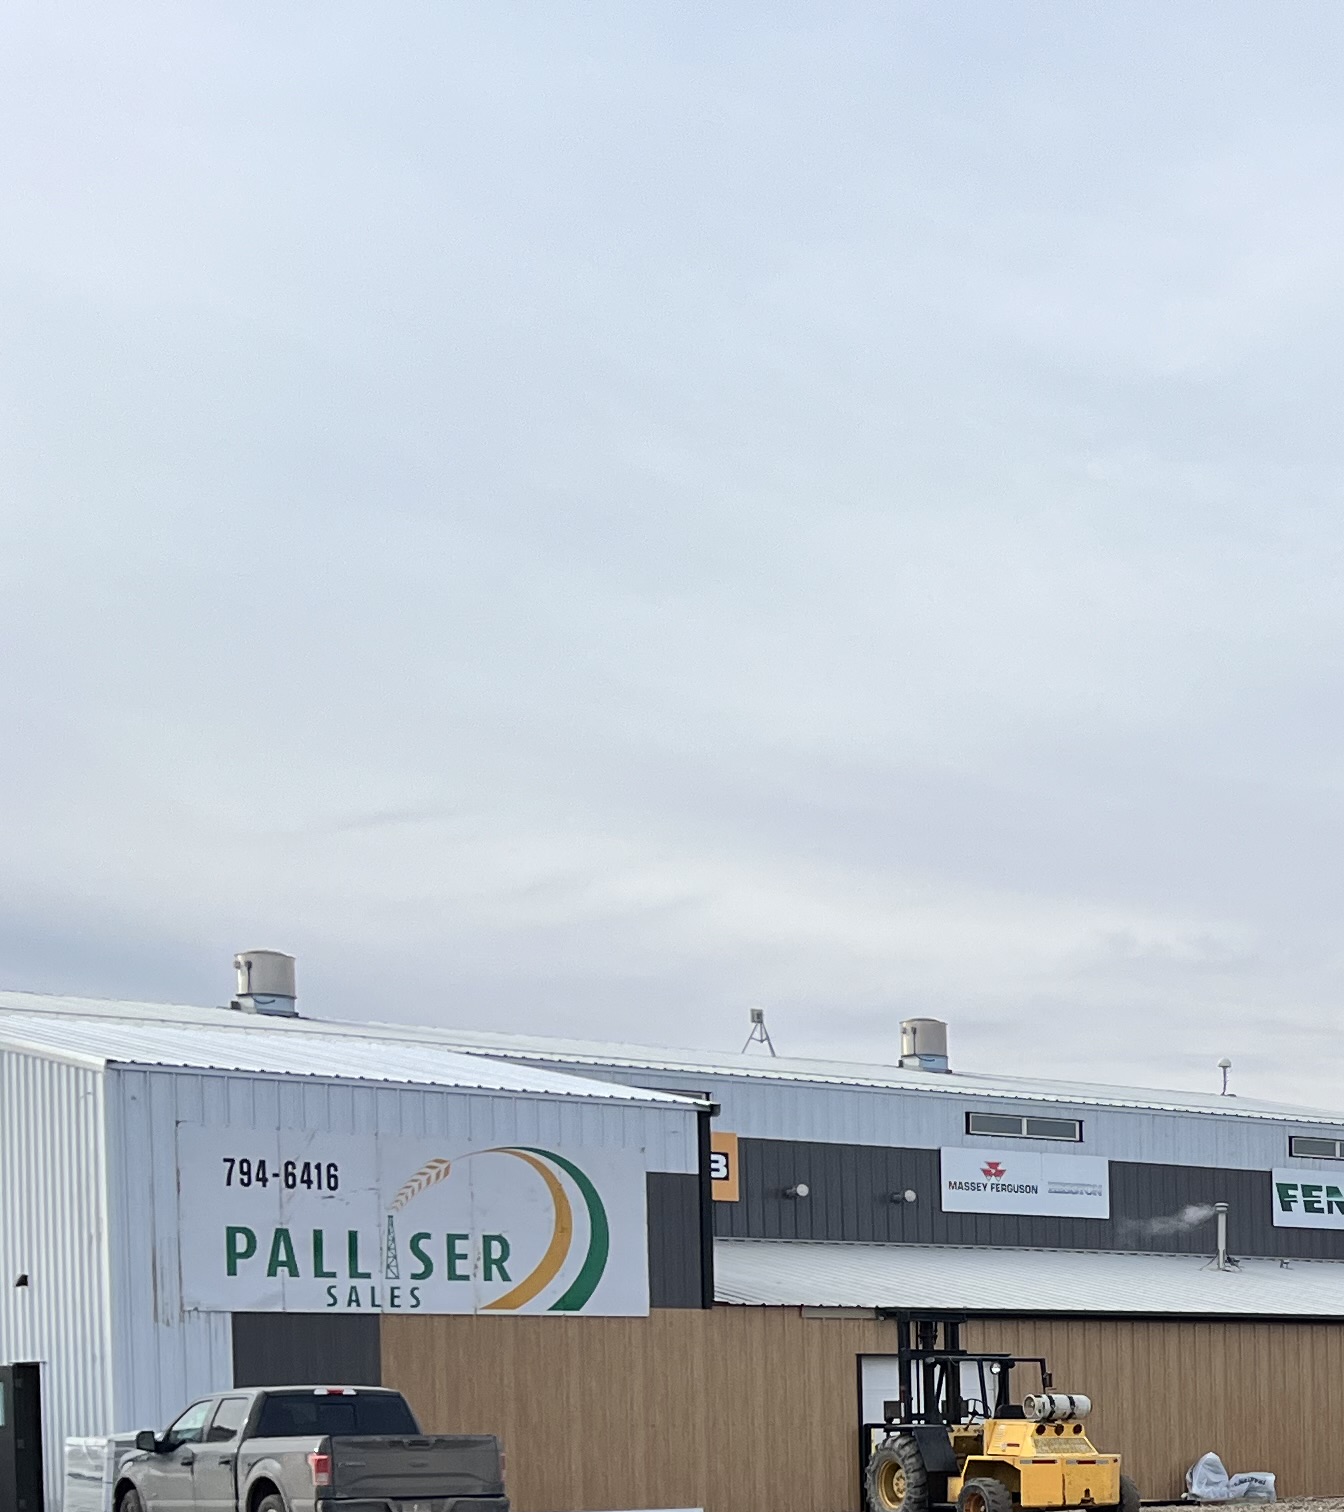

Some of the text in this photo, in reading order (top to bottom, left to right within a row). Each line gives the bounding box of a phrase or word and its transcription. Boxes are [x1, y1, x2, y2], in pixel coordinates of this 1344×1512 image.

[223, 1158, 340, 1191] 794-6416
[948, 1181, 1039, 1195] MASSEY FERGUSON
[326, 1285, 422, 1309] SALES
